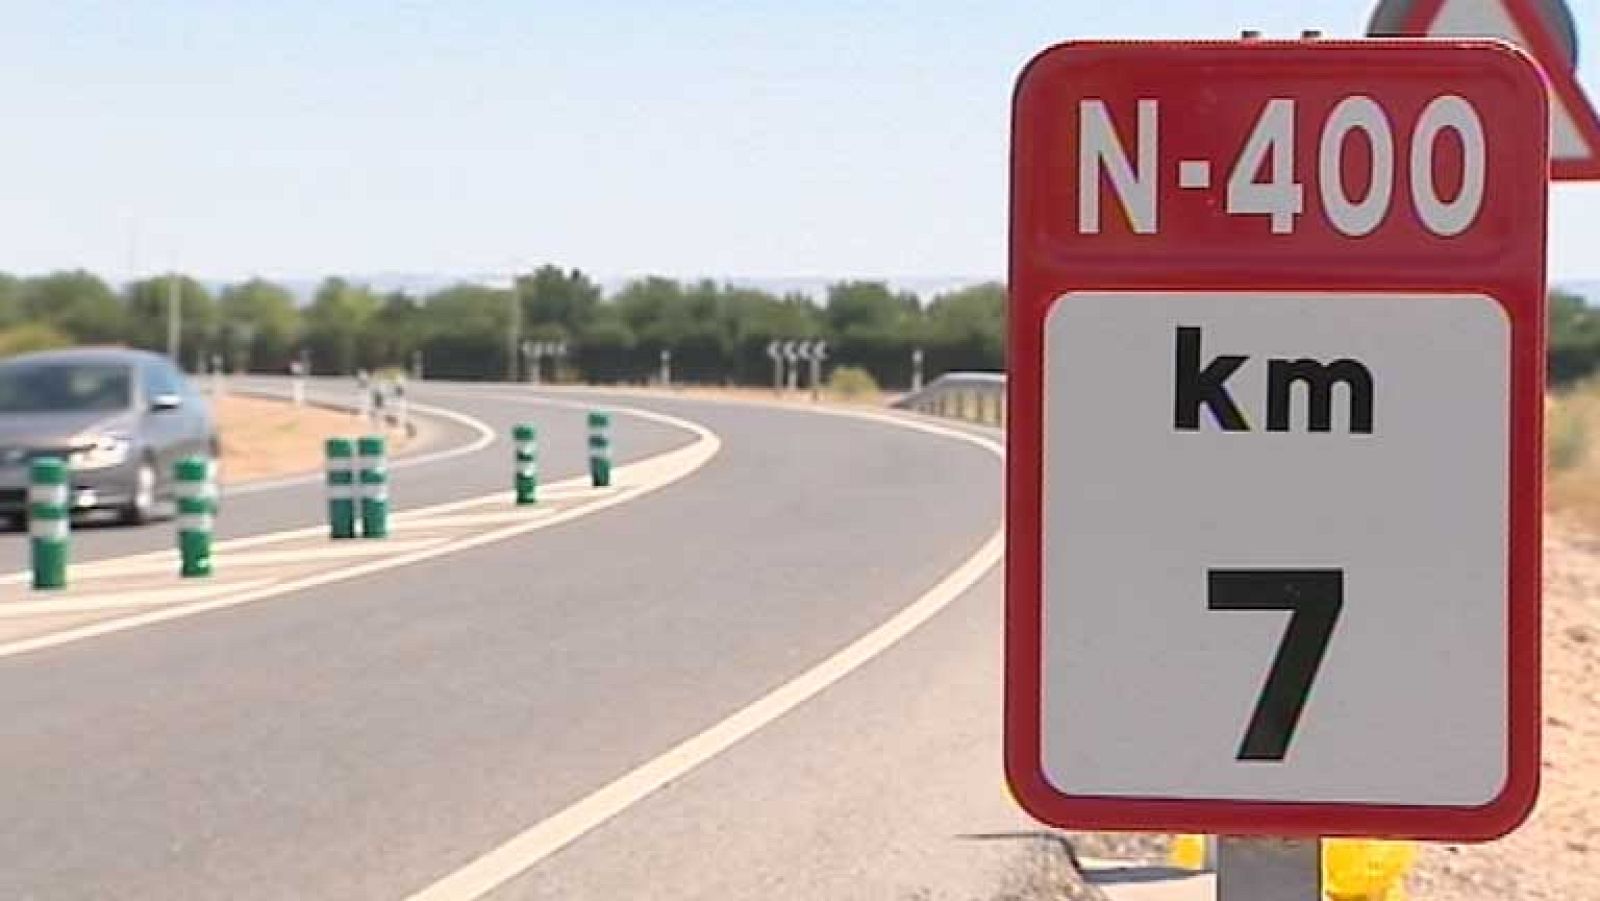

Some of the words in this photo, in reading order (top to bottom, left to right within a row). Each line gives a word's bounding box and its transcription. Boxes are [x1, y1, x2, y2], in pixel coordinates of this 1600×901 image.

[1078, 95, 1486, 237] N-400
[1174, 326, 1374, 434] km
[1207, 568, 1344, 761] 7
